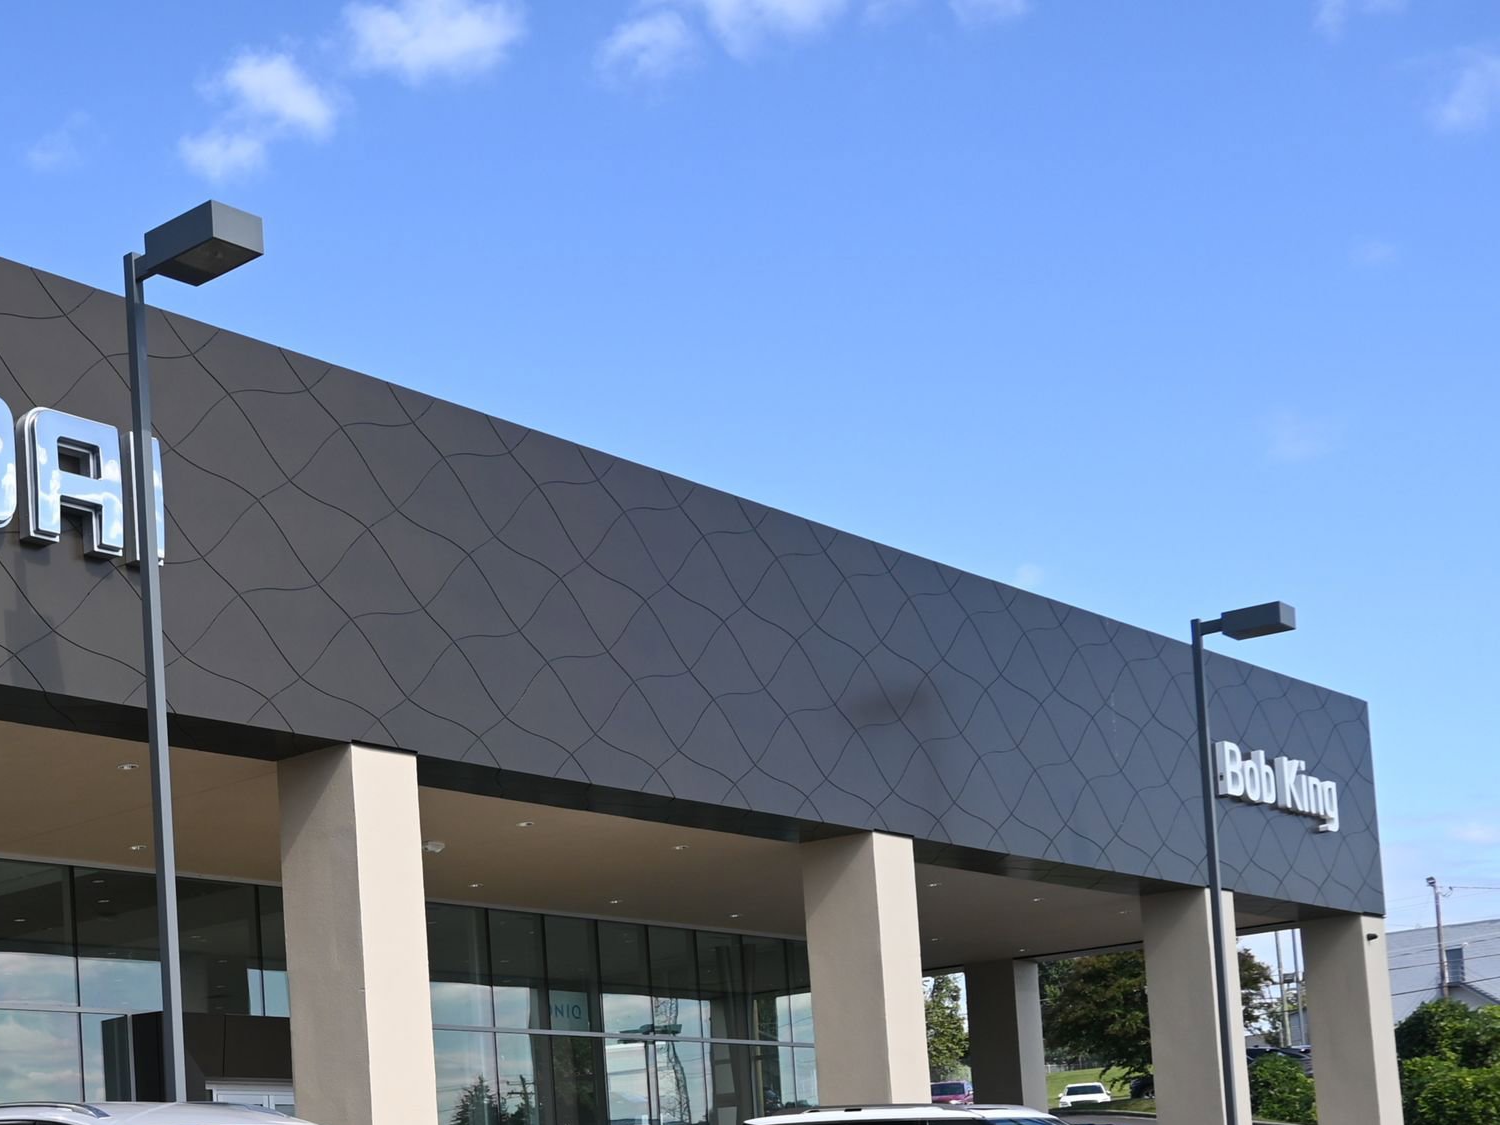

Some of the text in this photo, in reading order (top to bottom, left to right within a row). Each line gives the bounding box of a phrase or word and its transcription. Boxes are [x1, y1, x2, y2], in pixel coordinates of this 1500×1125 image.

[1215, 740, 1339, 832] Bob King
[550, 1003, 582, 1020] NIQ
